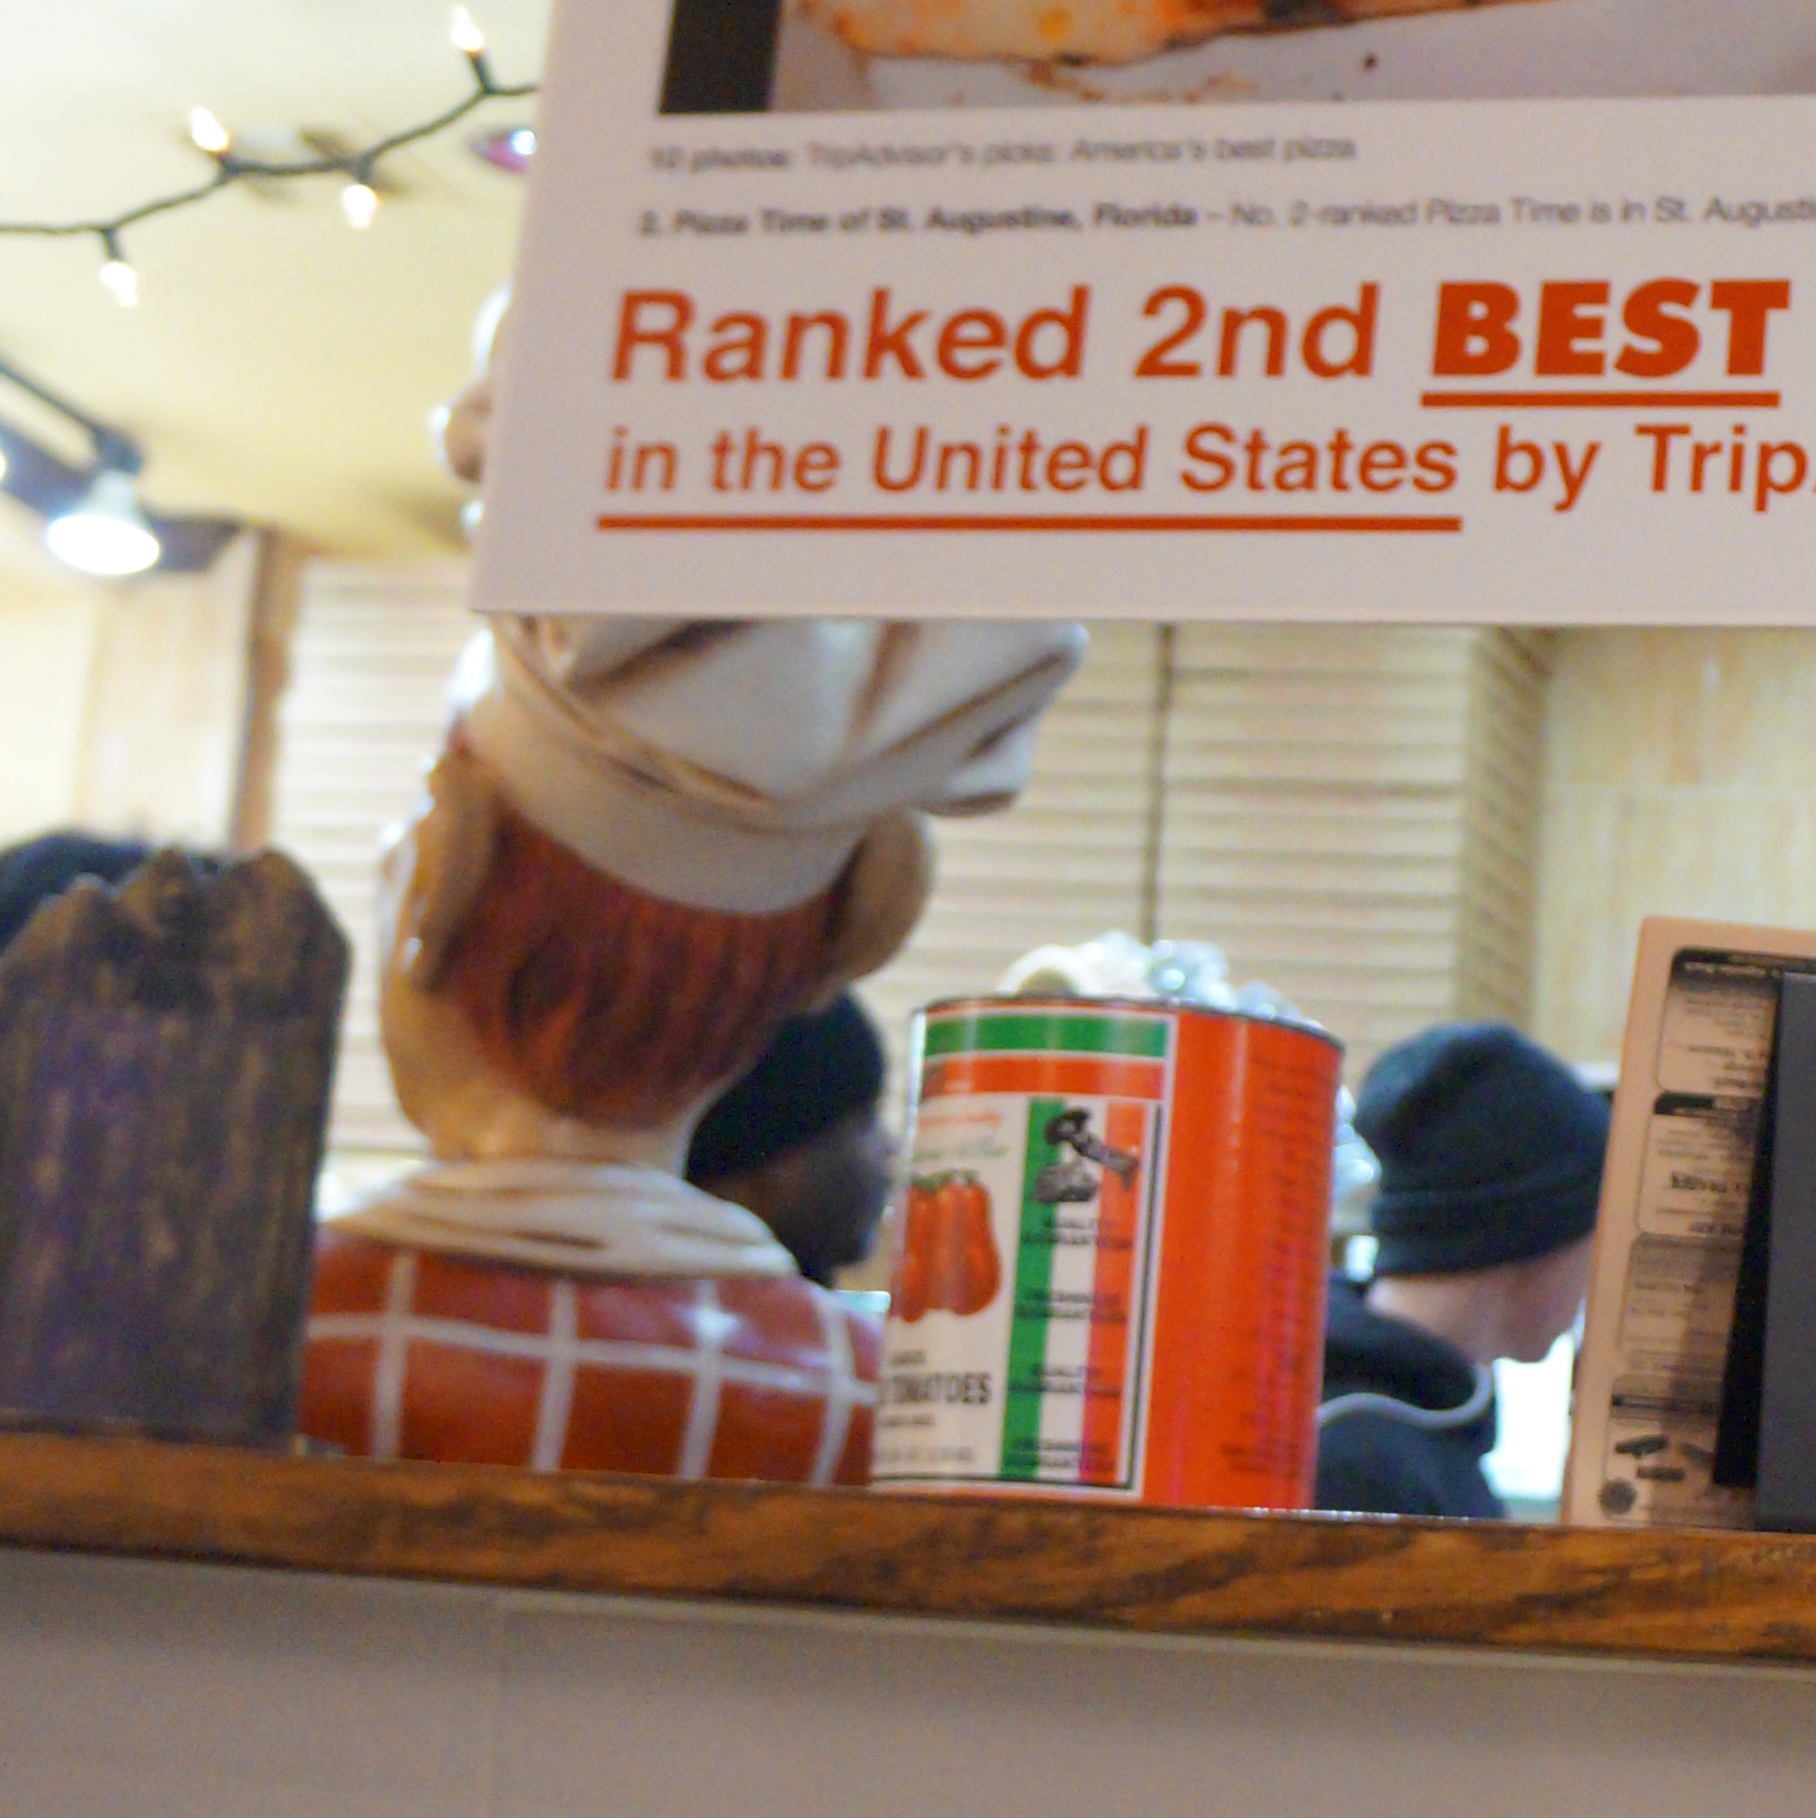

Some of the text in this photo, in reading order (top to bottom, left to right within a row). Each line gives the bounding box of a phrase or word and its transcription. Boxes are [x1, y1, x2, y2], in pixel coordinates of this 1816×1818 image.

[1425, 196, 1501, 226] Pizza
[1511, 195, 1583, 225] Time
[1589, 196, 1612, 224] is
[1619, 194, 1646, 224] in
[1653, 194, 1690, 224] St.
[611, 284, 1090, 384] Ranked
[1133, 281, 1379, 380] 2nd
[1431, 277, 1791, 379] BEST
[605, 427, 678, 493] in
[710, 428, 841, 494] the
[872, 425, 1149, 494] United
[1180, 422, 1457, 494] States
[1493, 424, 1600, 513] by
